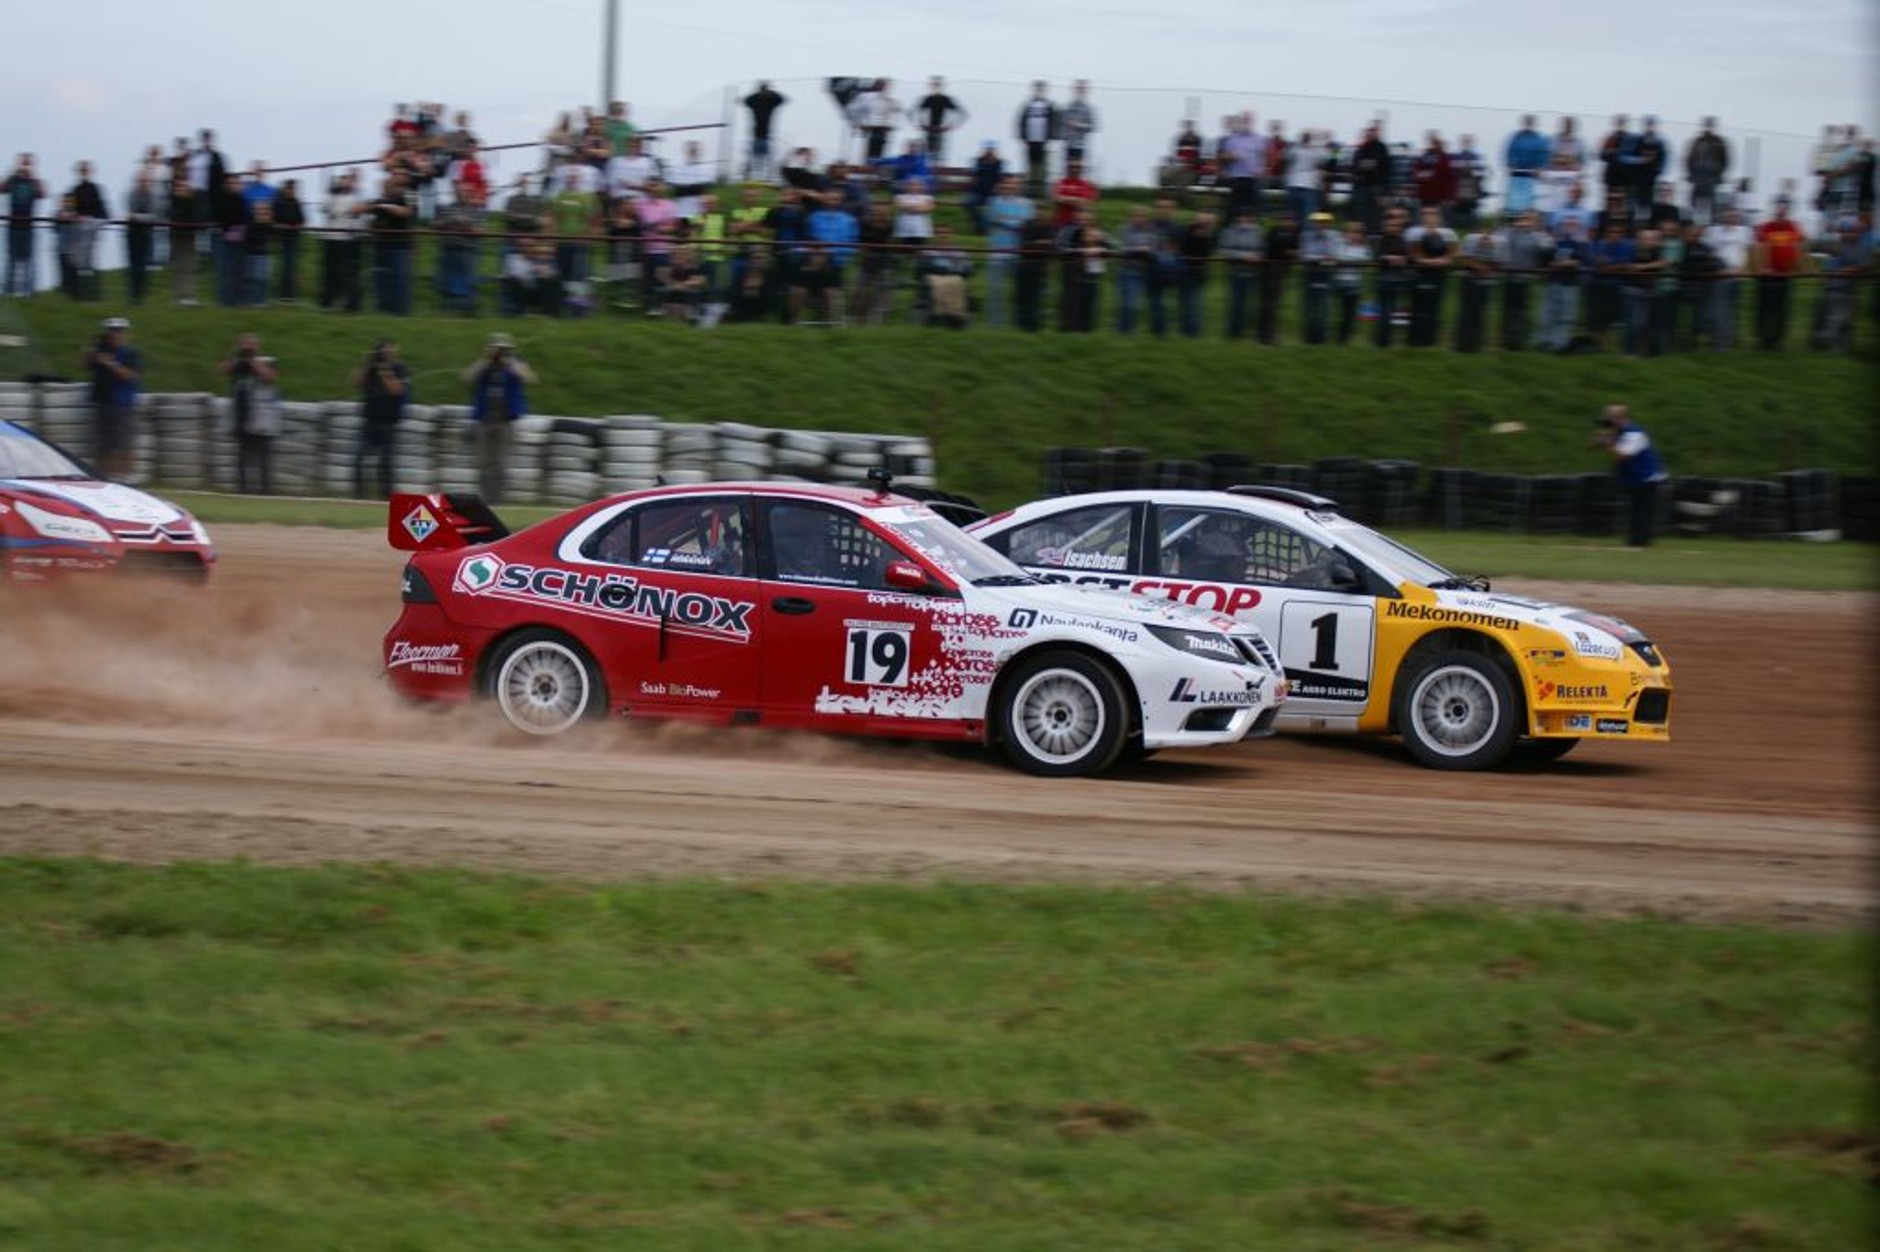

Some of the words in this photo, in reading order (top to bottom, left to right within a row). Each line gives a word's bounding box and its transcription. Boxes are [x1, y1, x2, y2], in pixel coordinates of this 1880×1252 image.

[1063, 549, 1128, 571] Isachsen
[501, 562, 755, 634] SCHÖNOX
[1386, 600, 1520, 631] Mekonomen
[1184, 634, 1240, 658] Makita
[1308, 611, 1340, 672] 1
[849, 629, 907, 684] 19
[641, 681, 667, 694] Saab
[1200, 690, 1263, 704] LAAKKONEN
[1327, 687, 1367, 697] ELEKTRO
[1557, 684, 1608, 699] RELEKTA
